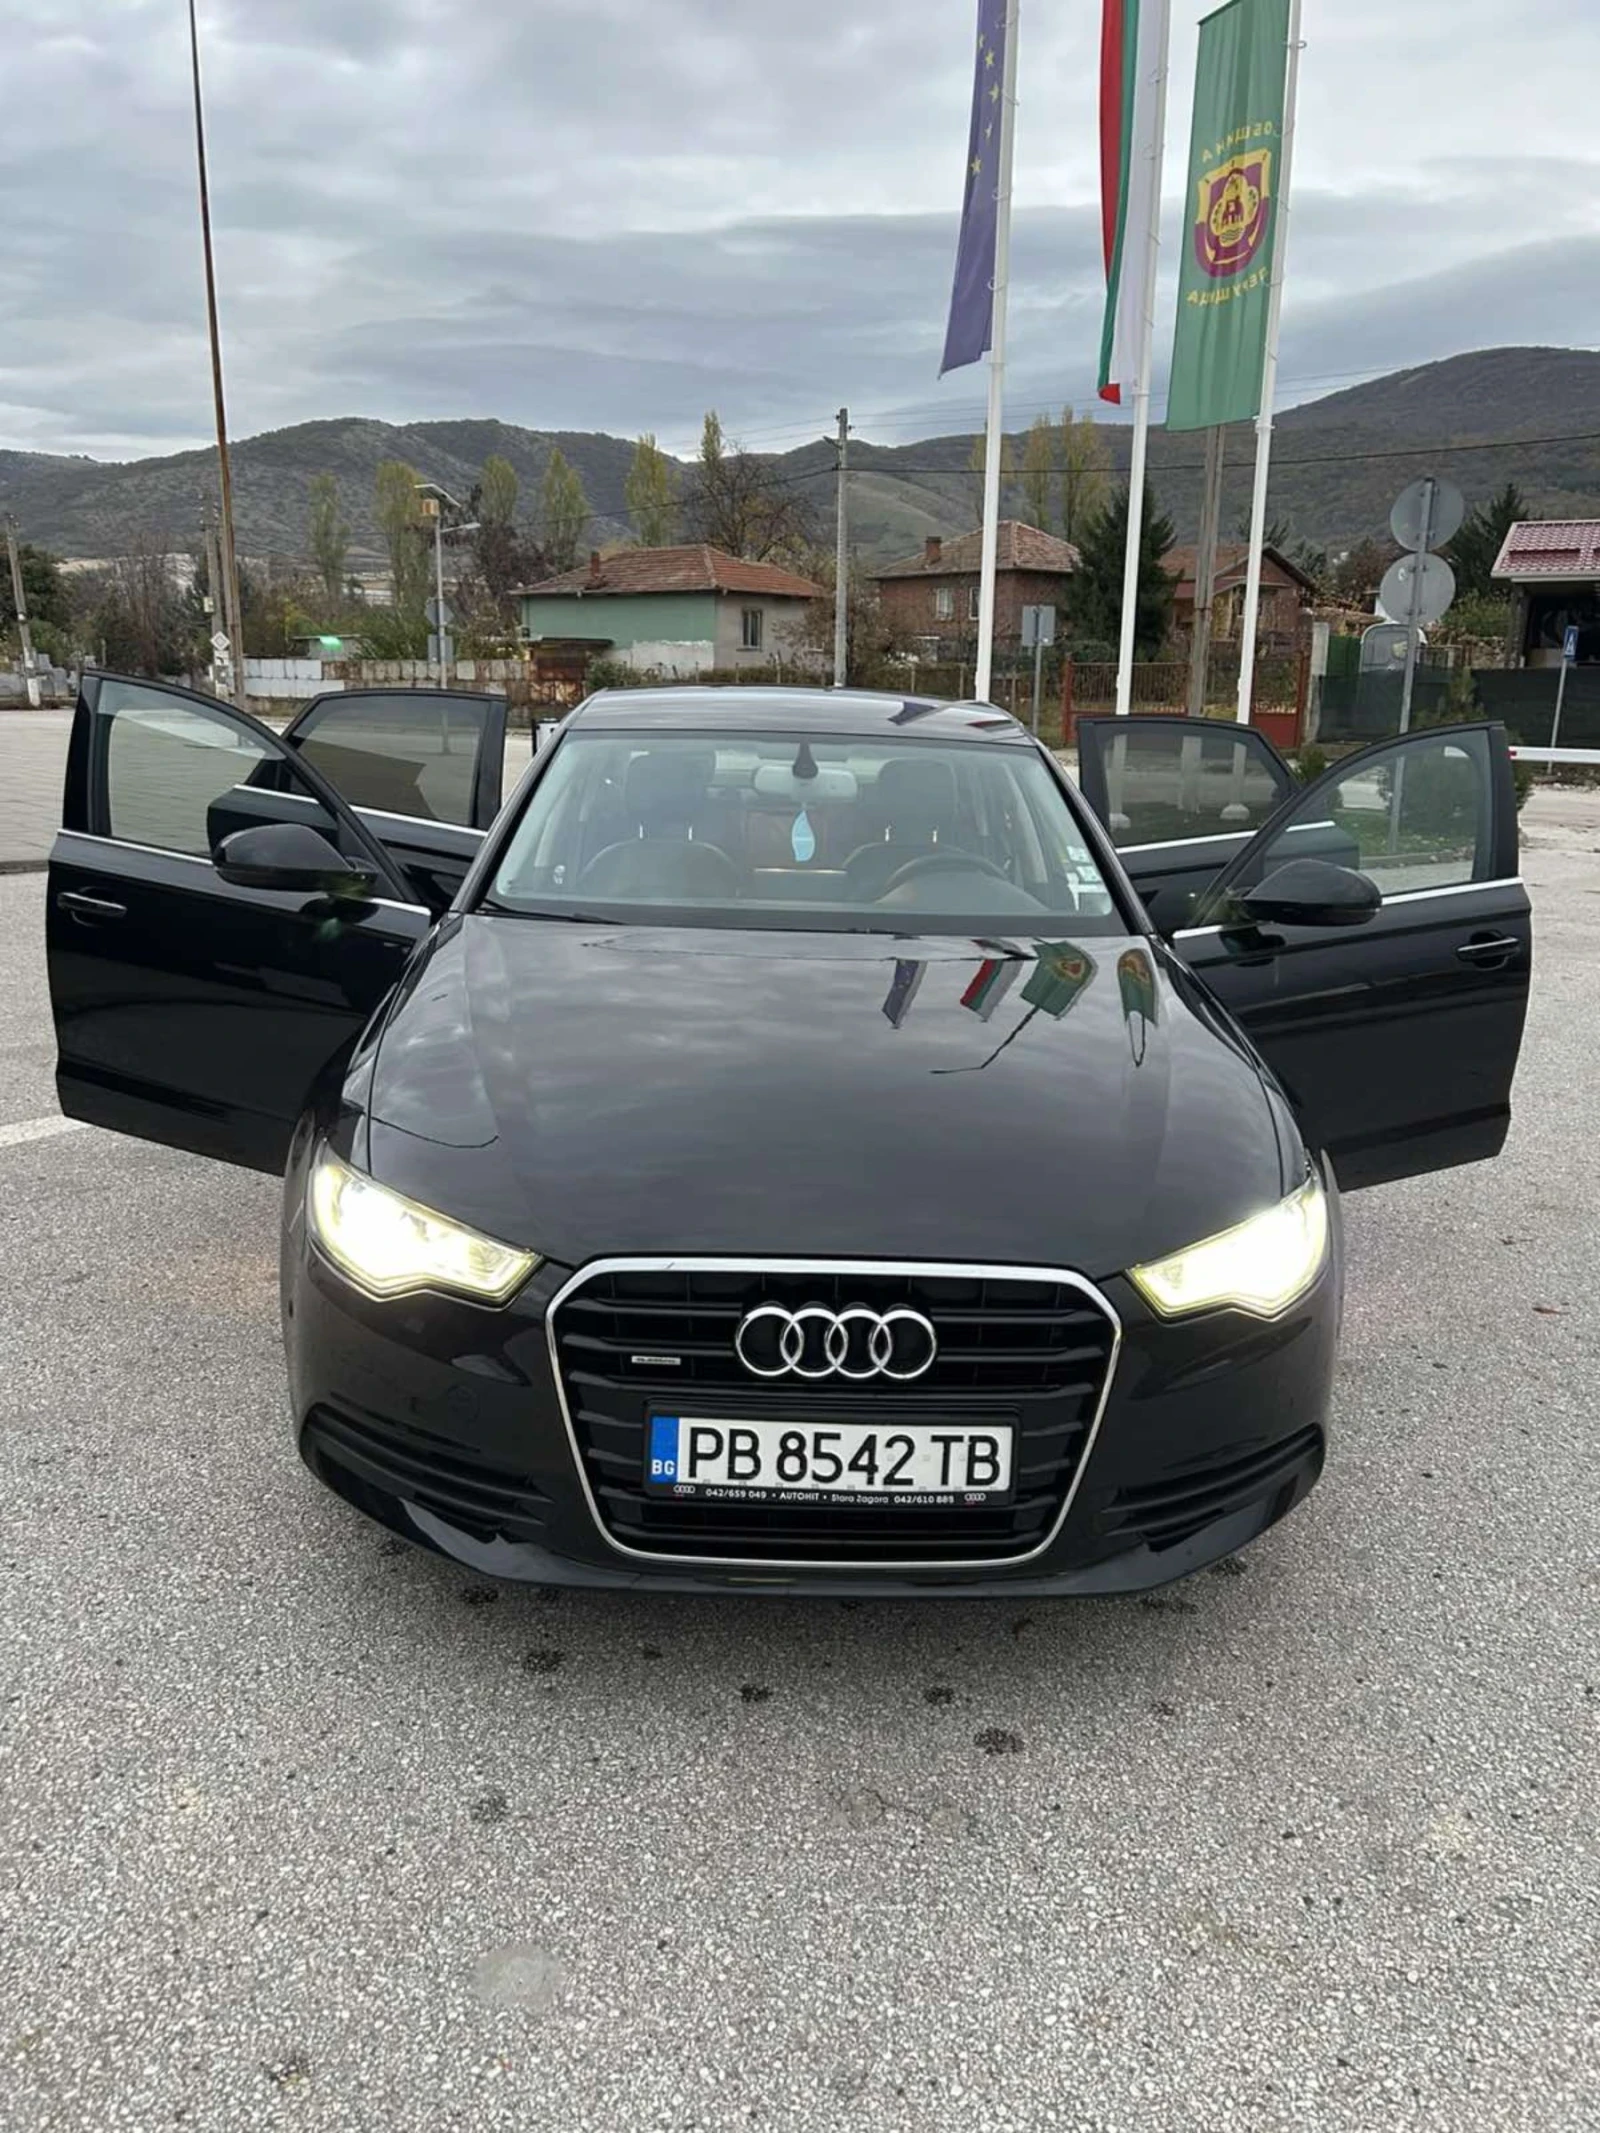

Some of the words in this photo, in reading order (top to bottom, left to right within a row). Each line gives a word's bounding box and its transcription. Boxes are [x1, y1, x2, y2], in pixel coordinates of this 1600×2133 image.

[688, 1426, 761, 1481] PB
[776, 1430, 915, 1486] 8542
[930, 1434, 1000, 1486] TB
[651, 1460, 676, 1475] BG
[779, 1491, 820, 1501] AUTOHIT
